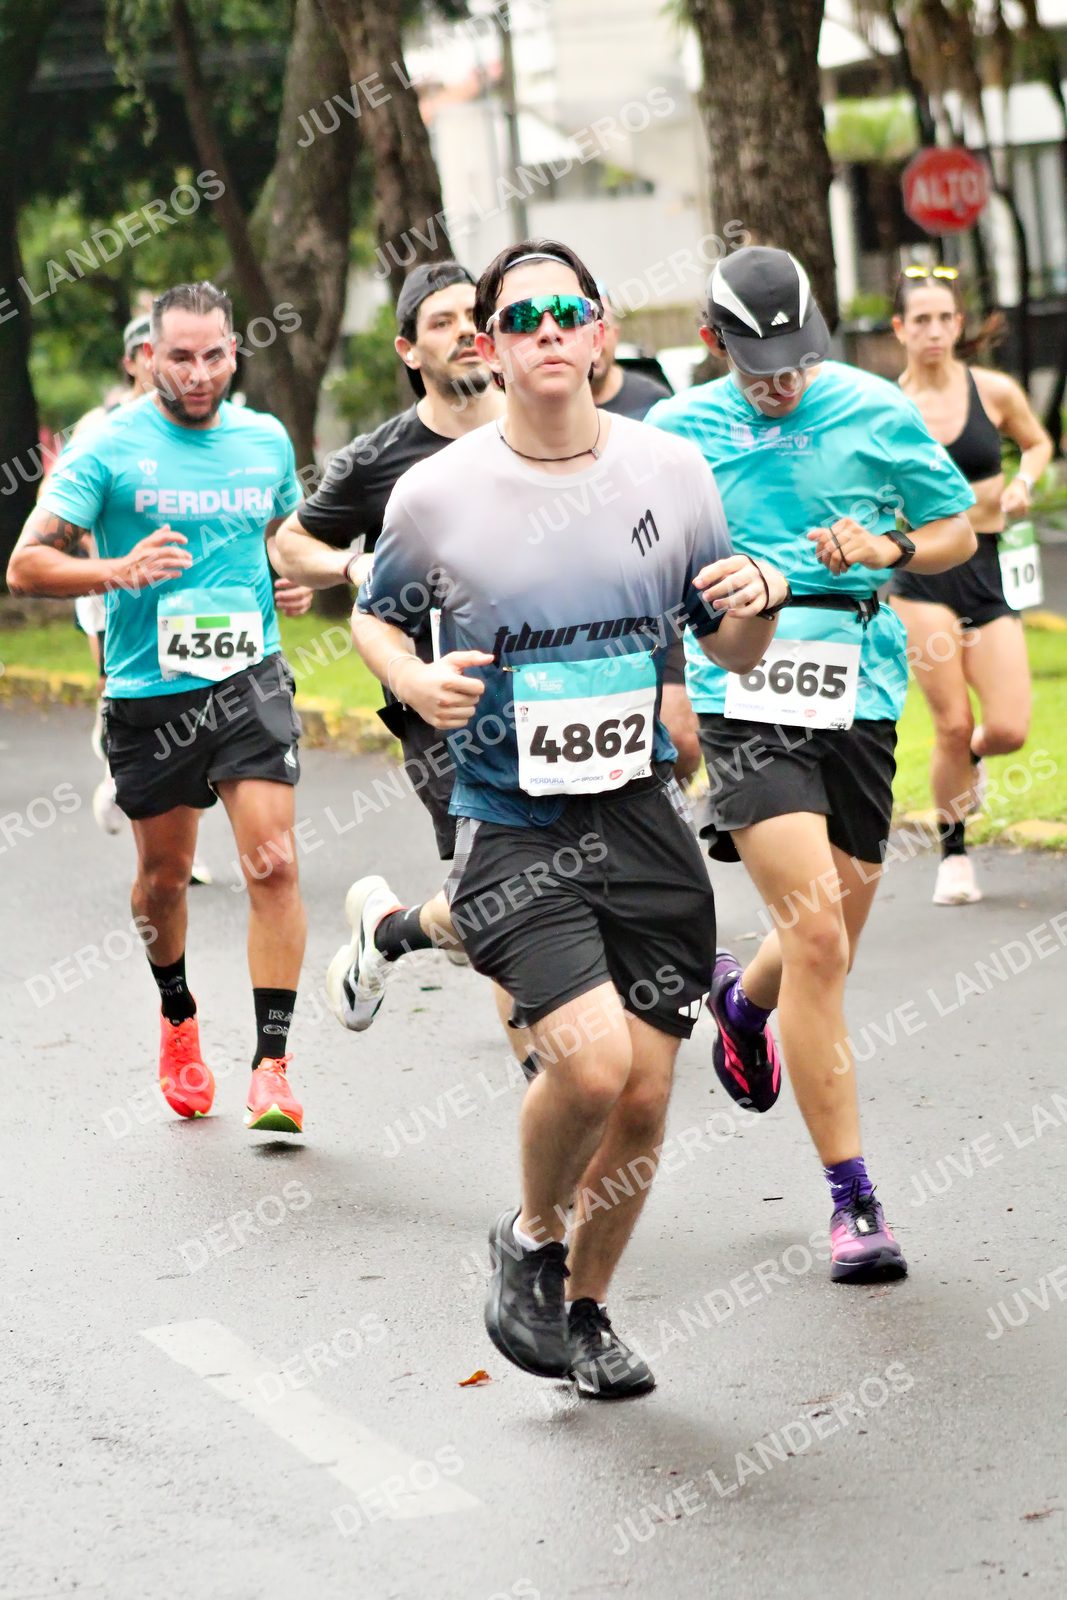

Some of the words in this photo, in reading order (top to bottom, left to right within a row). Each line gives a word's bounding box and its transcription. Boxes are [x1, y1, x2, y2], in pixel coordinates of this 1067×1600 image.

[910, 170, 980, 208] ALTO
[135, 486, 273, 514] PERDURA
[167, 631, 257, 660] 4364
[740, 659, 847, 699] 6665
[530, 714, 645, 763] 4862
